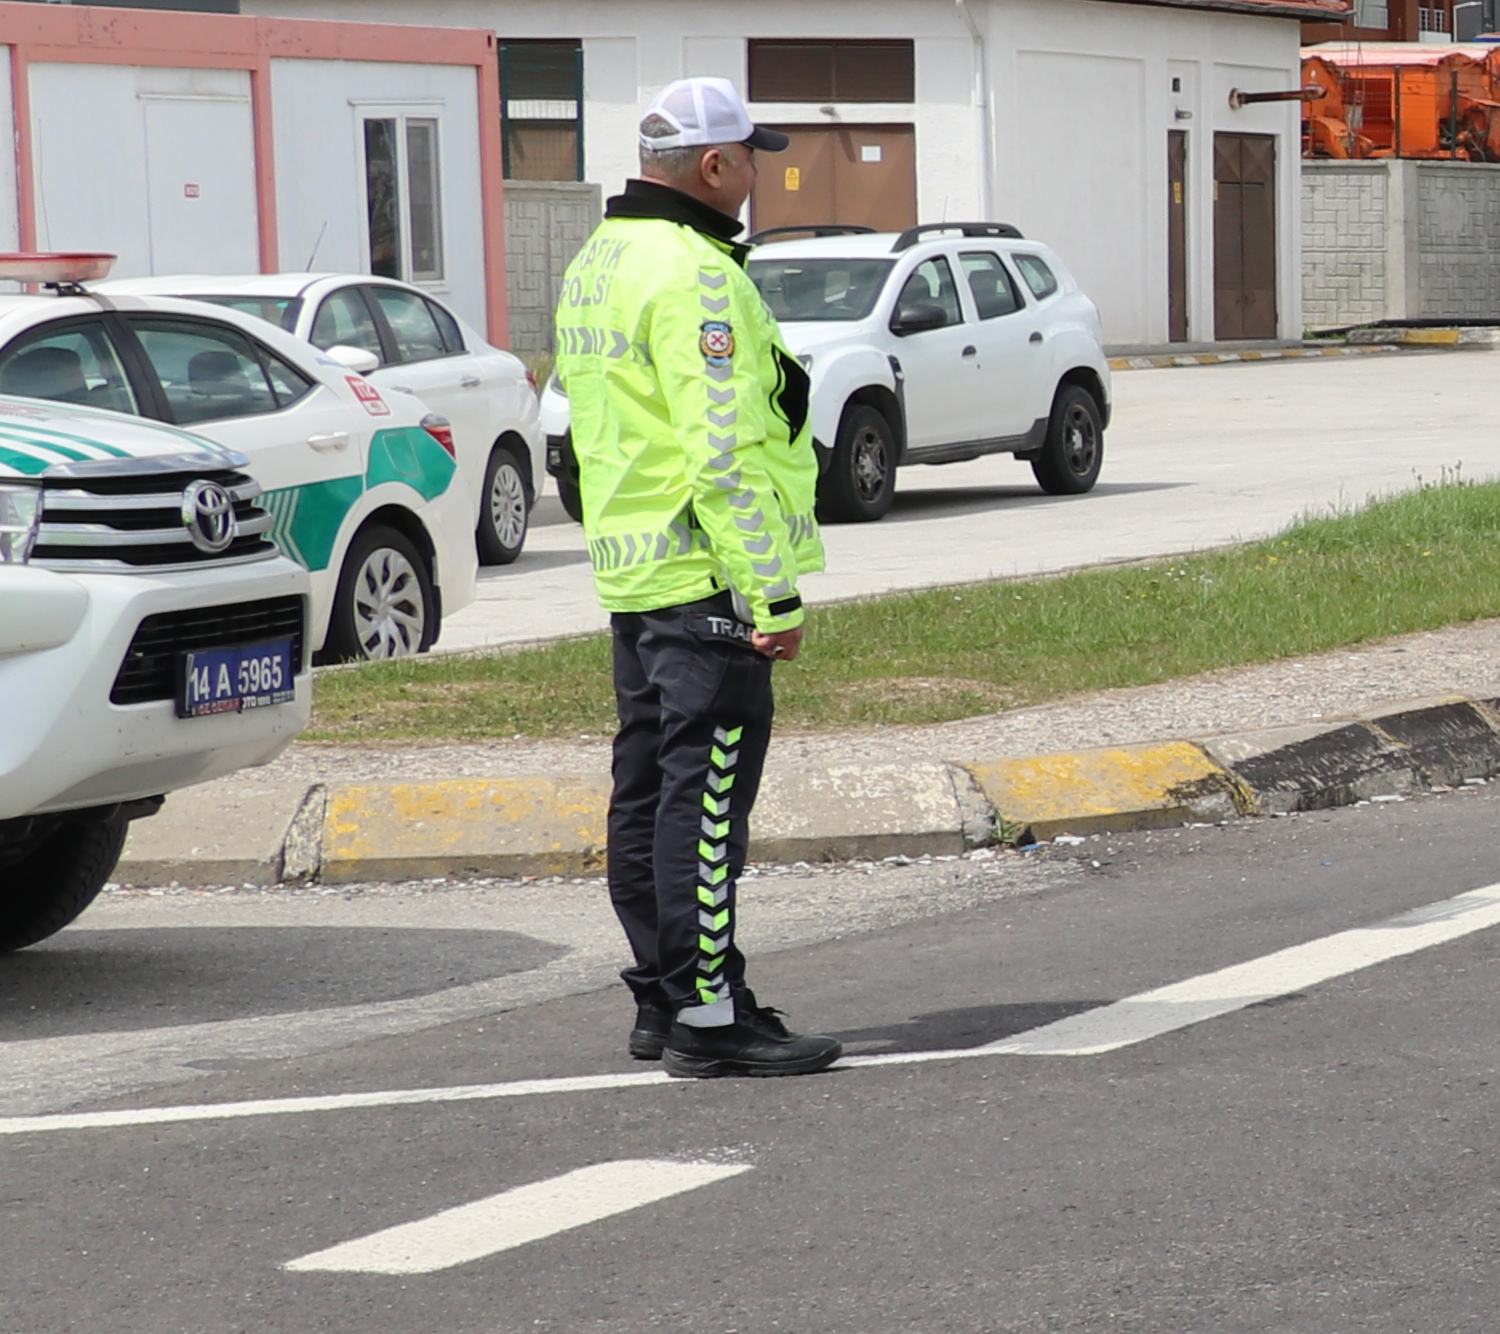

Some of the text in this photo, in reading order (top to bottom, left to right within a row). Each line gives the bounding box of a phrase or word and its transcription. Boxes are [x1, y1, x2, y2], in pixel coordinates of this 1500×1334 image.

[190, 655, 282, 701] 14 A 5965
